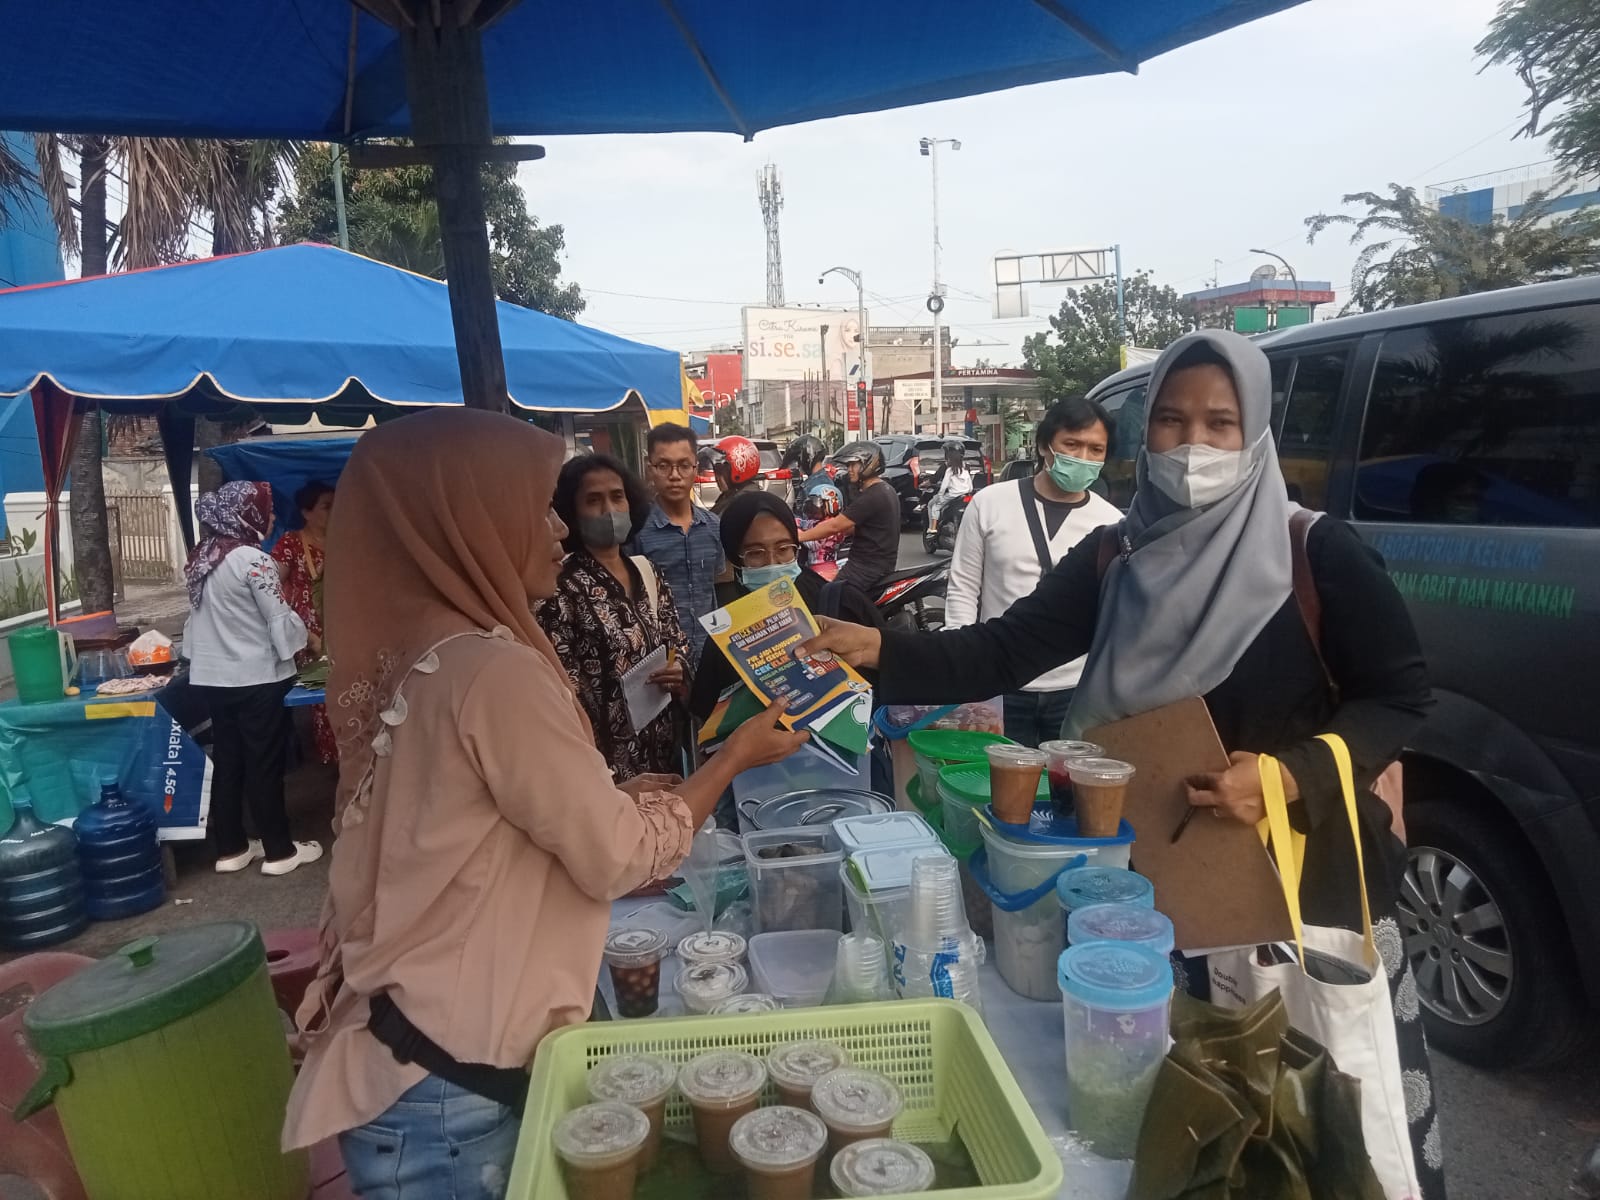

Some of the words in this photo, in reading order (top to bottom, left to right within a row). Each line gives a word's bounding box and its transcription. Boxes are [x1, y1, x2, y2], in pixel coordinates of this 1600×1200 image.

[957, 368, 999, 376] PERTAMINA
[1419, 573, 1456, 600] OBAT
[1459, 577, 1490, 607] DAN
[1492, 580, 1576, 617] MAKANAN
[164, 767, 177, 795] 4.5G
